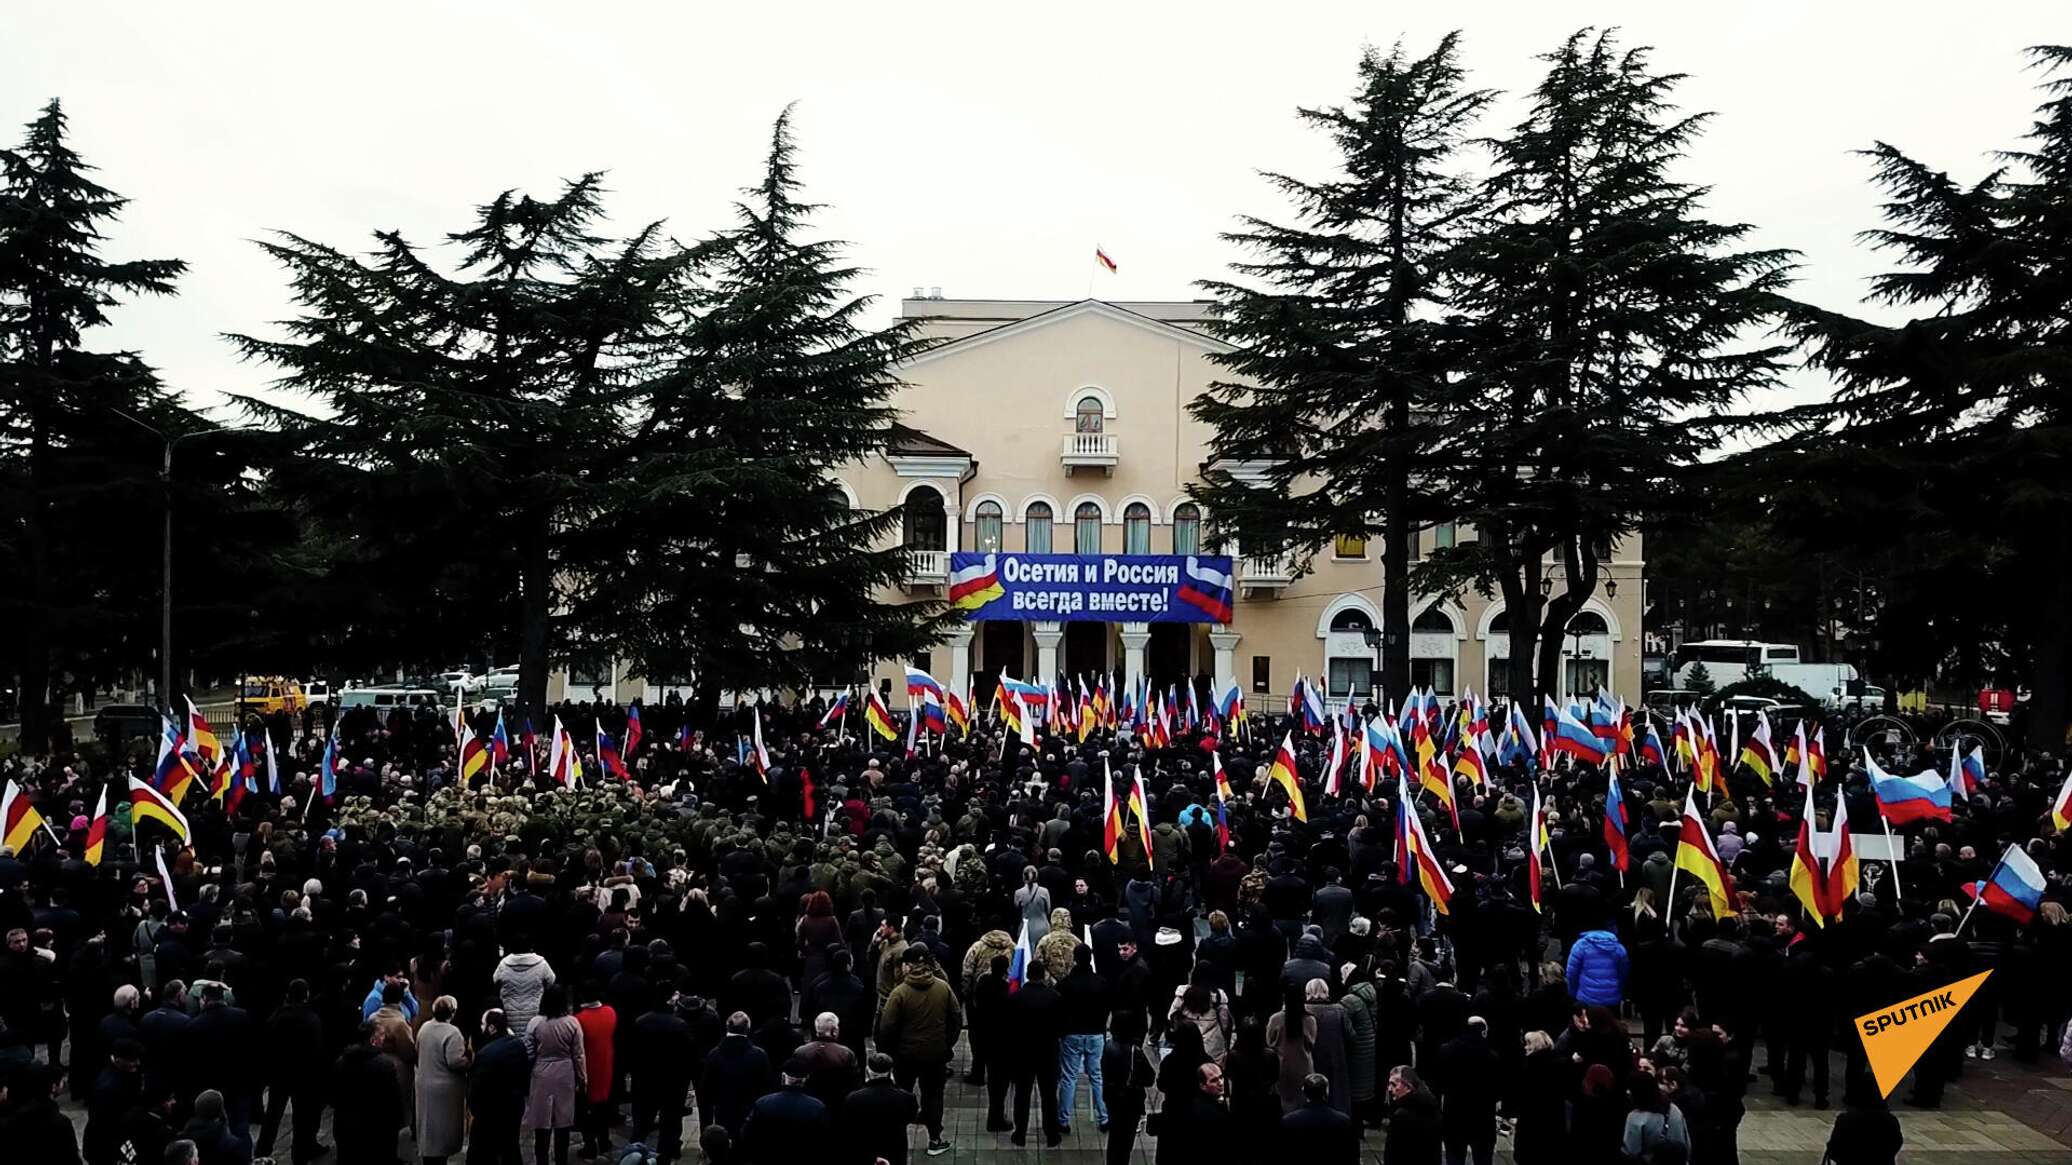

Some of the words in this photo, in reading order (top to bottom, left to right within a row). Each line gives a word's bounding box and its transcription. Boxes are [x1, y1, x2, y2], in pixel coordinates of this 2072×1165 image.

[1003, 557, 1078, 583] Осетия
[1085, 563, 1097, 582] и
[1104, 559, 1178, 584] Россия
[1013, 591, 1082, 613] всегда
[1089, 588, 1168, 612] вместе!
